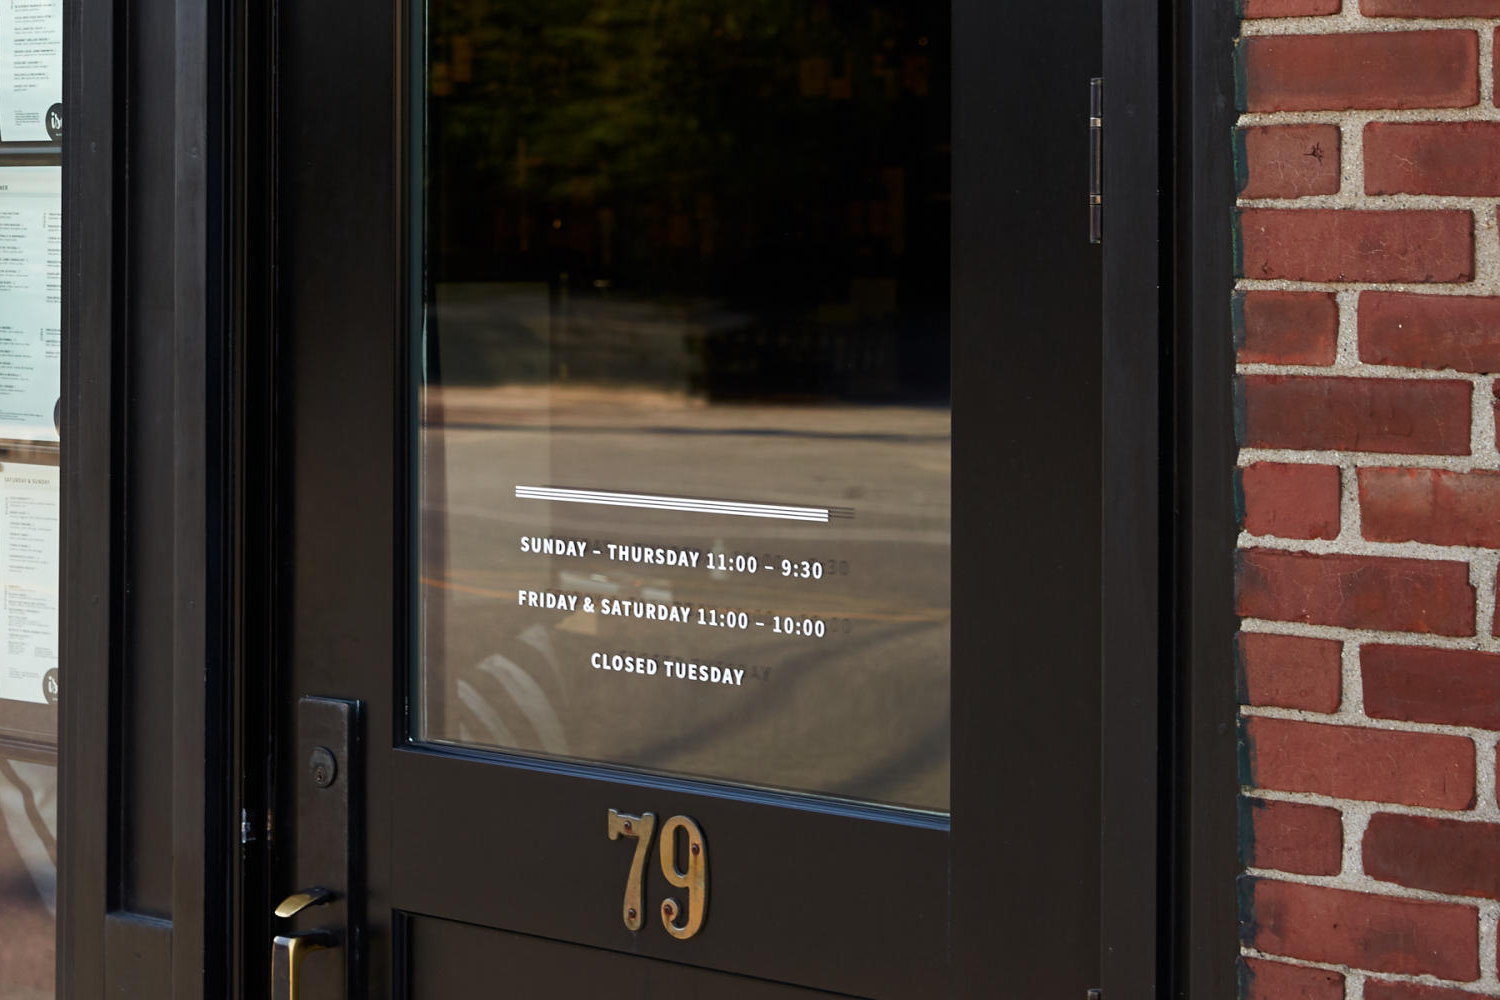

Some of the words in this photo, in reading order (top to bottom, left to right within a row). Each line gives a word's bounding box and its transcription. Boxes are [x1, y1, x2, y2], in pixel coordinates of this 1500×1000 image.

[520, 536, 587, 557] SUNDAY
[607, 543, 699, 568] THURSDAY
[706, 552, 758, 574] 11:00
[781, 559, 823, 579] 9:30
[518, 590, 578, 612] FRIDAY
[583, 597, 595, 613] &
[601, 598, 691, 623] SATURDAY
[697, 608, 749, 630] 11:00
[772, 615, 826, 638] 10:00
[591, 652, 658, 675] CLOSED
[664, 660, 745, 686] TUESDAY
[608, 808, 708, 940] 79
